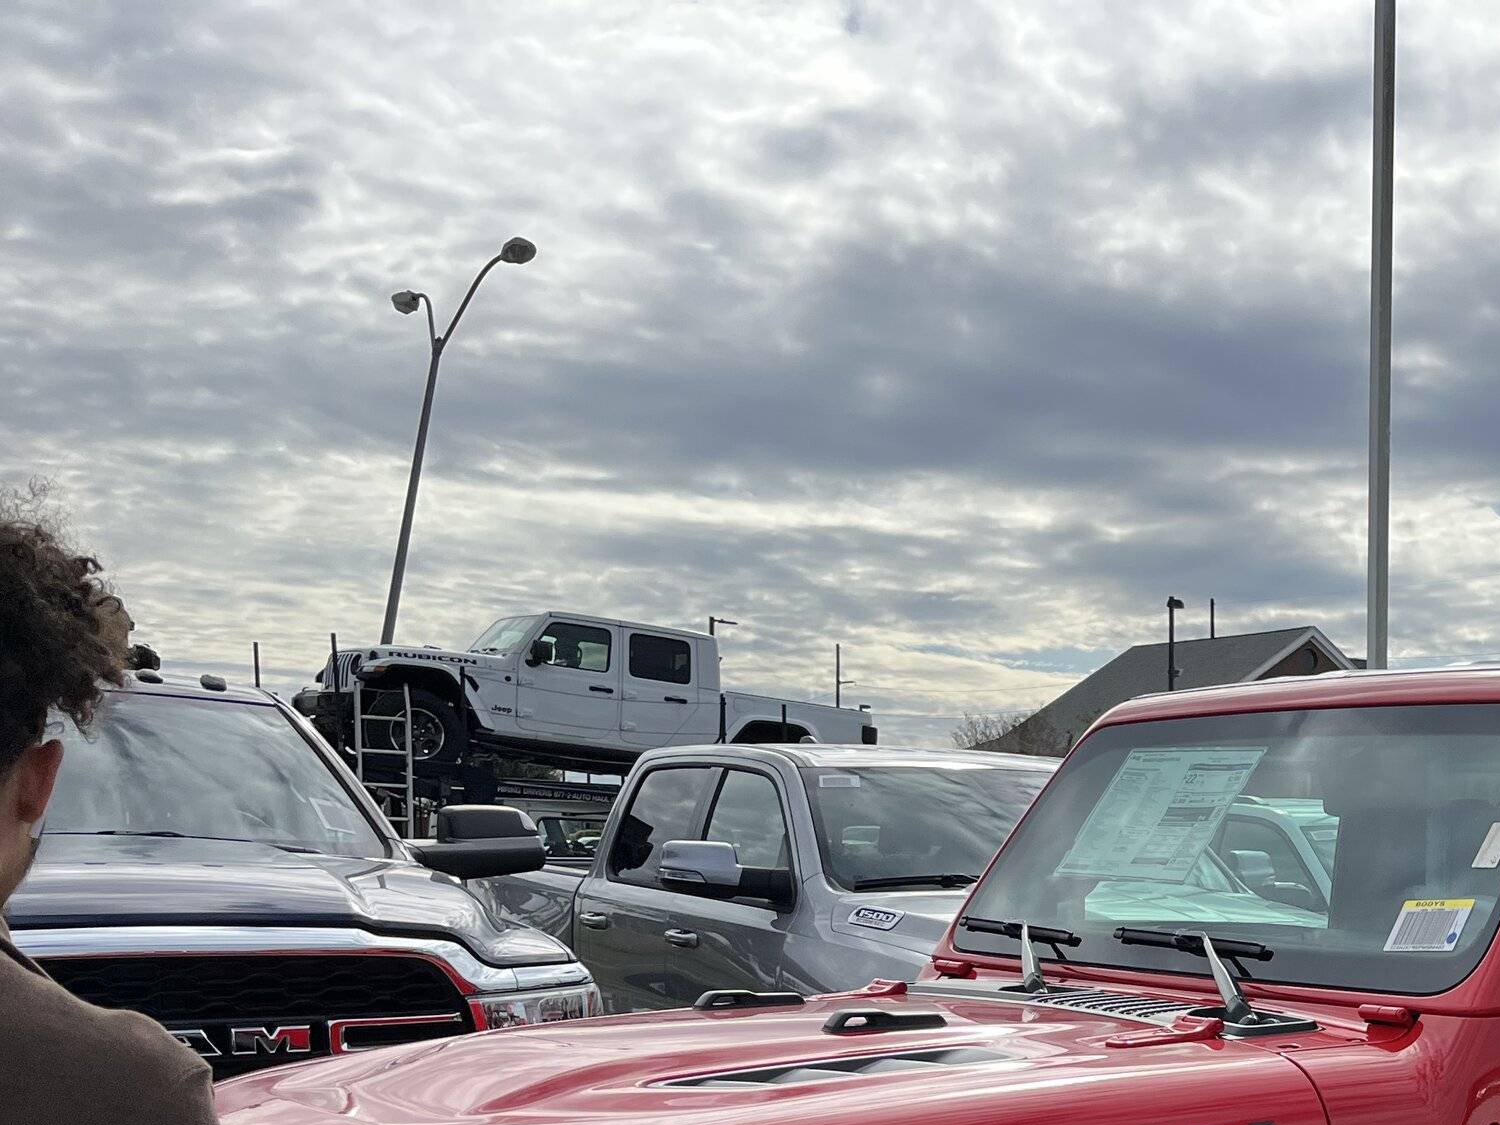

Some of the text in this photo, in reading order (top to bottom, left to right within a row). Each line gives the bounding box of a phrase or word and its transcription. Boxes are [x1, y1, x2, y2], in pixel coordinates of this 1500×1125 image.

[388, 650, 478, 666] RUBICON
[491, 704, 513, 714] Jeep
[858, 909, 896, 922] 1500
[168, 1025, 312, 1056] AM
